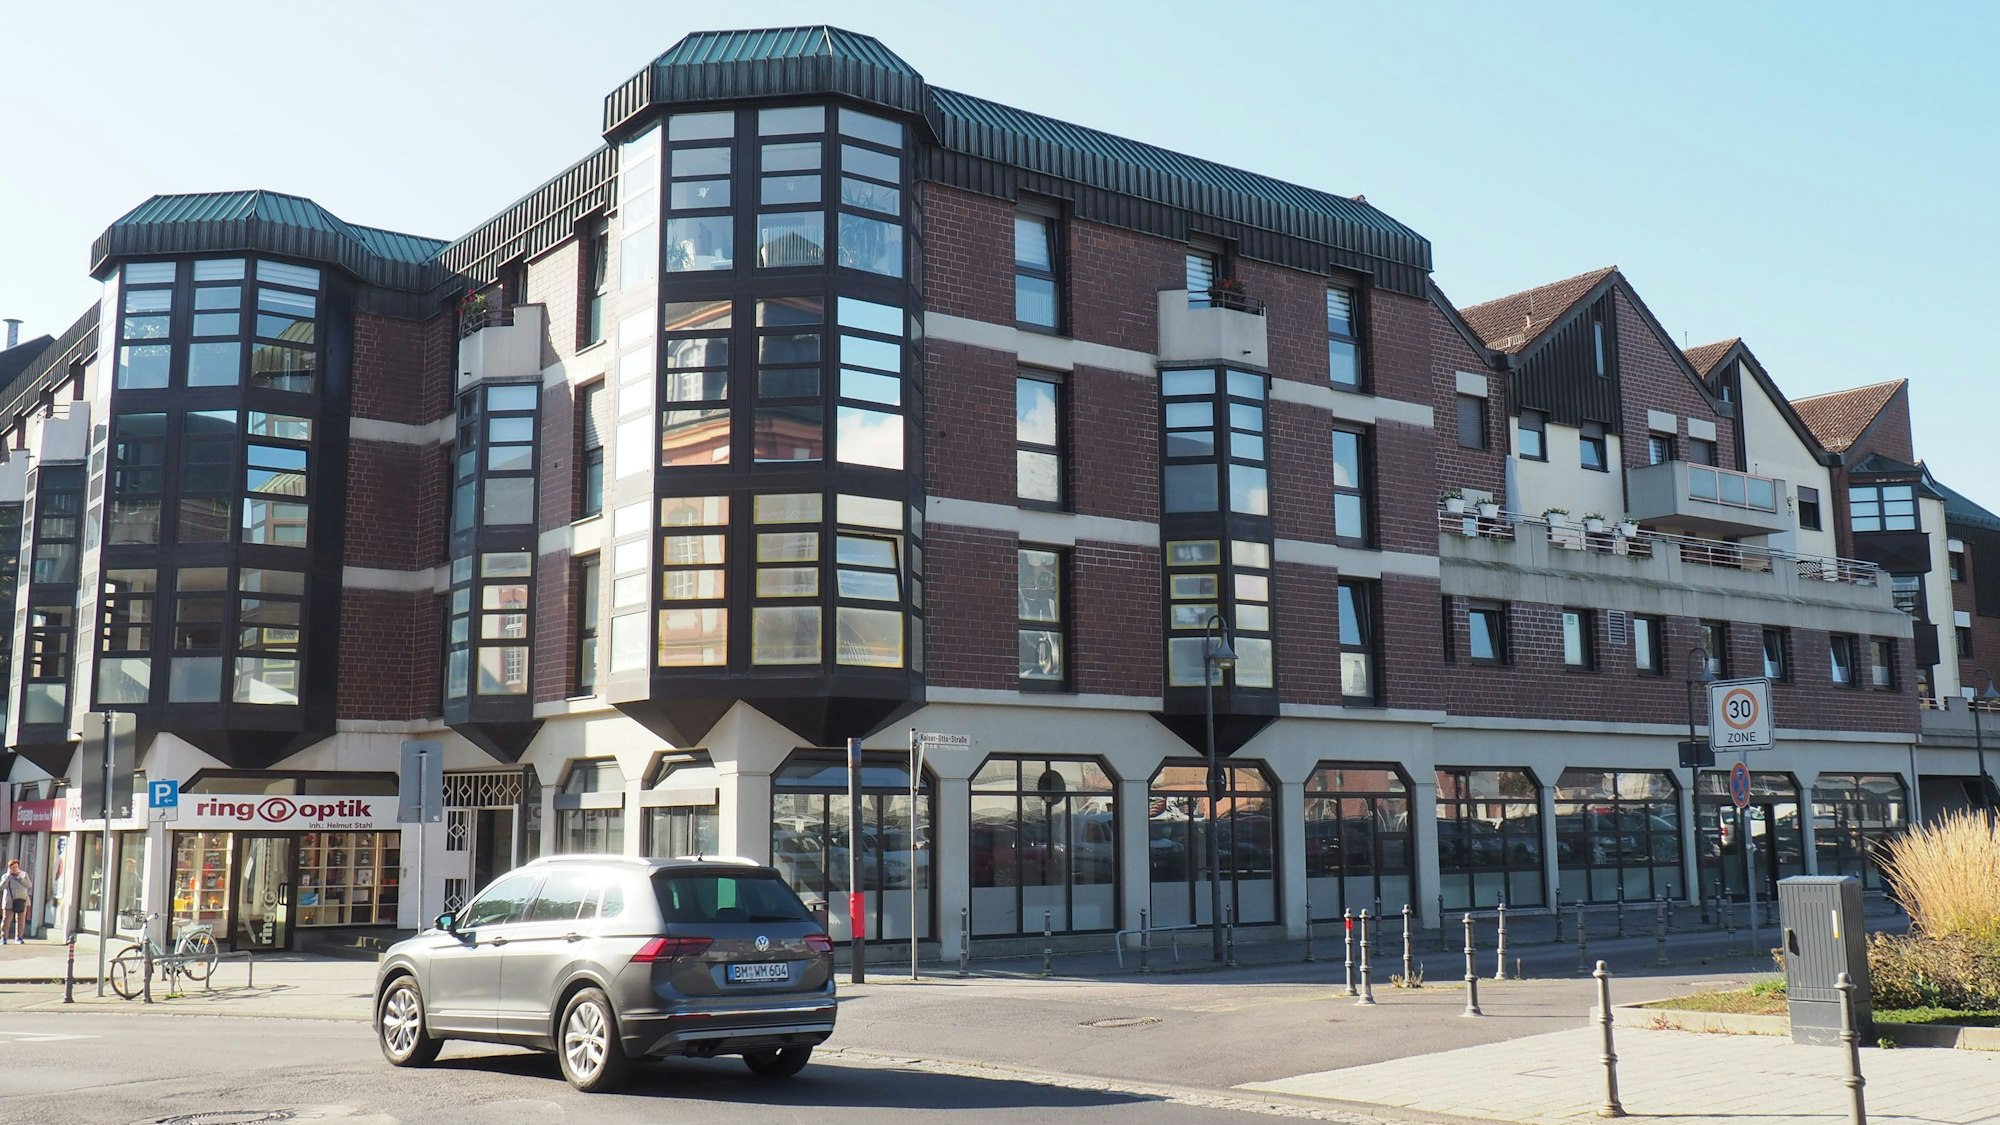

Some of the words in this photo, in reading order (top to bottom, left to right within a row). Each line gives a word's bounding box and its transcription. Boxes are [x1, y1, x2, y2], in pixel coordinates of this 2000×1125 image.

[1729, 699, 1751, 719] 30
[1727, 732, 1756, 743] ZONE
[155, 784, 172, 805] P
[196, 798, 255, 821] ring
[299, 799, 372, 822] optik
[259, 912, 276, 945] ring
[734, 965, 749, 978] BM
[754, 964, 768, 977] WM
[769, 964, 787, 976] 604
